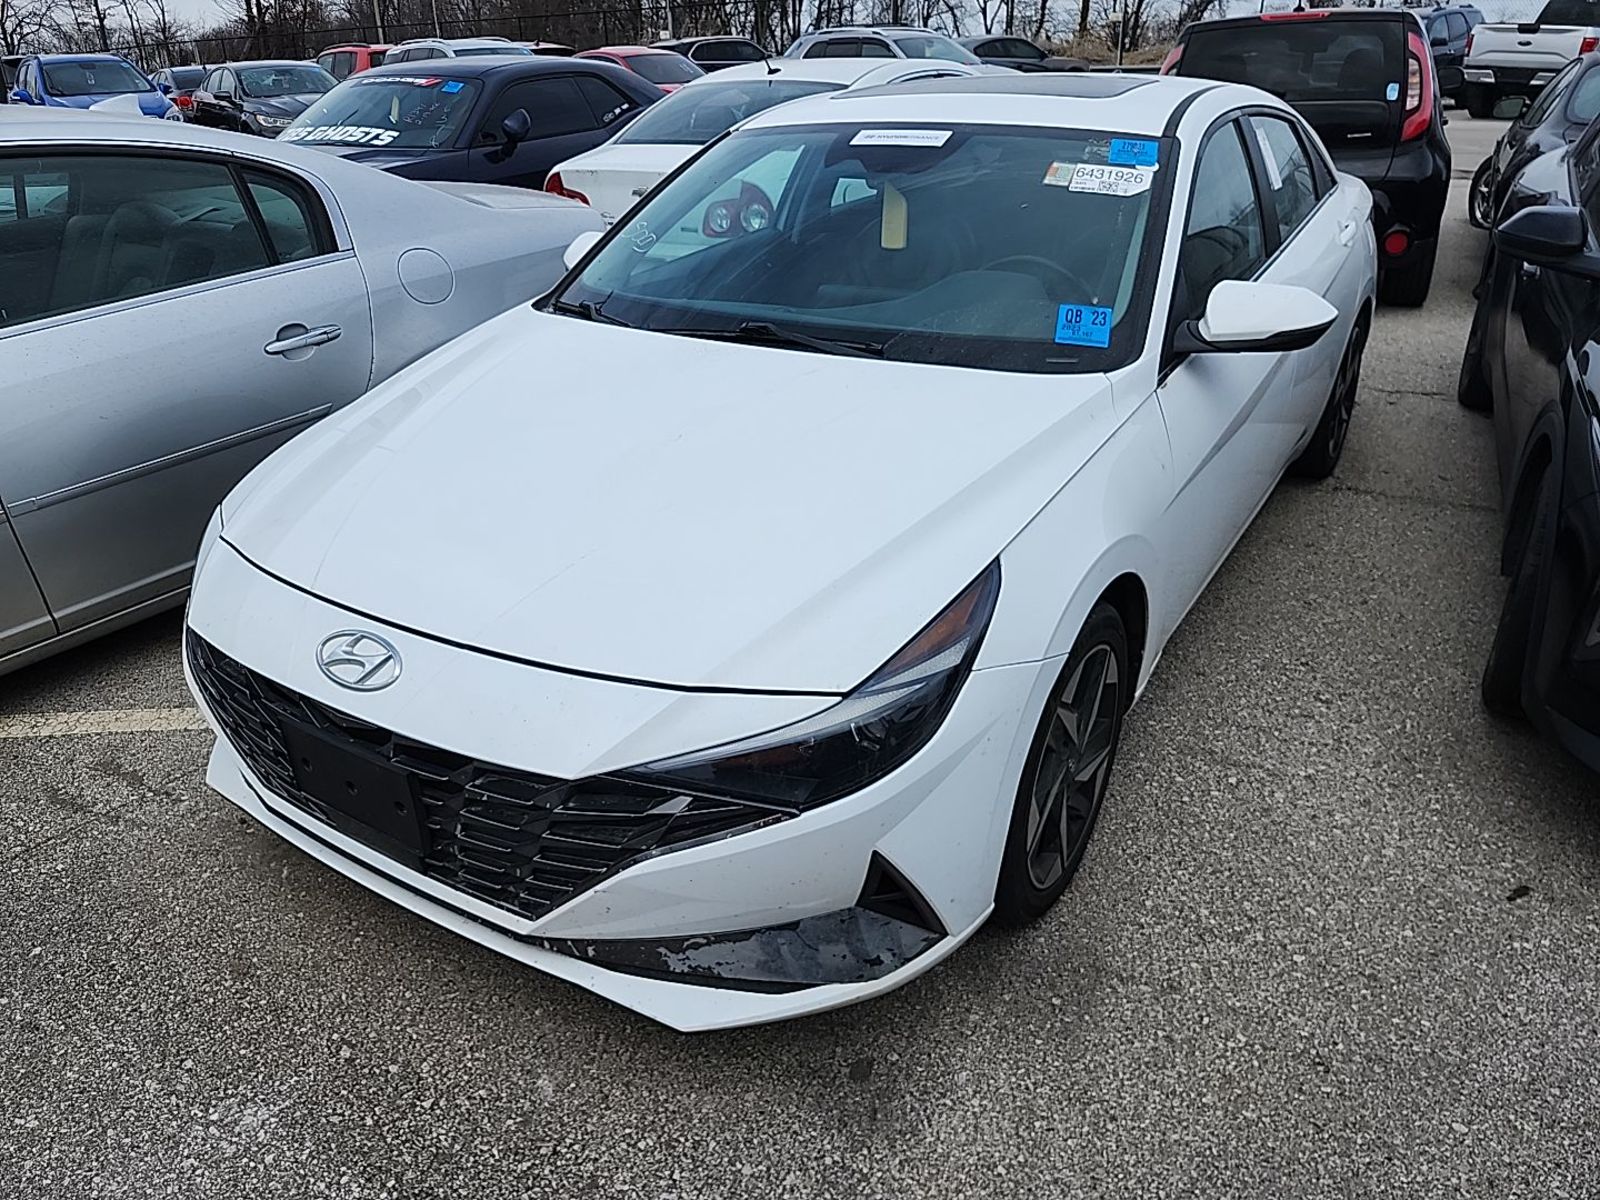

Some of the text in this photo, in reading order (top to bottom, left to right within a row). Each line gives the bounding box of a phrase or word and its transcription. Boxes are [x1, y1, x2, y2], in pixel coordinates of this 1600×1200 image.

[303, 126, 400, 146] GHOSTS
[1076, 167, 1145, 184] 6431926
[1065, 308, 1107, 326] QB 23
